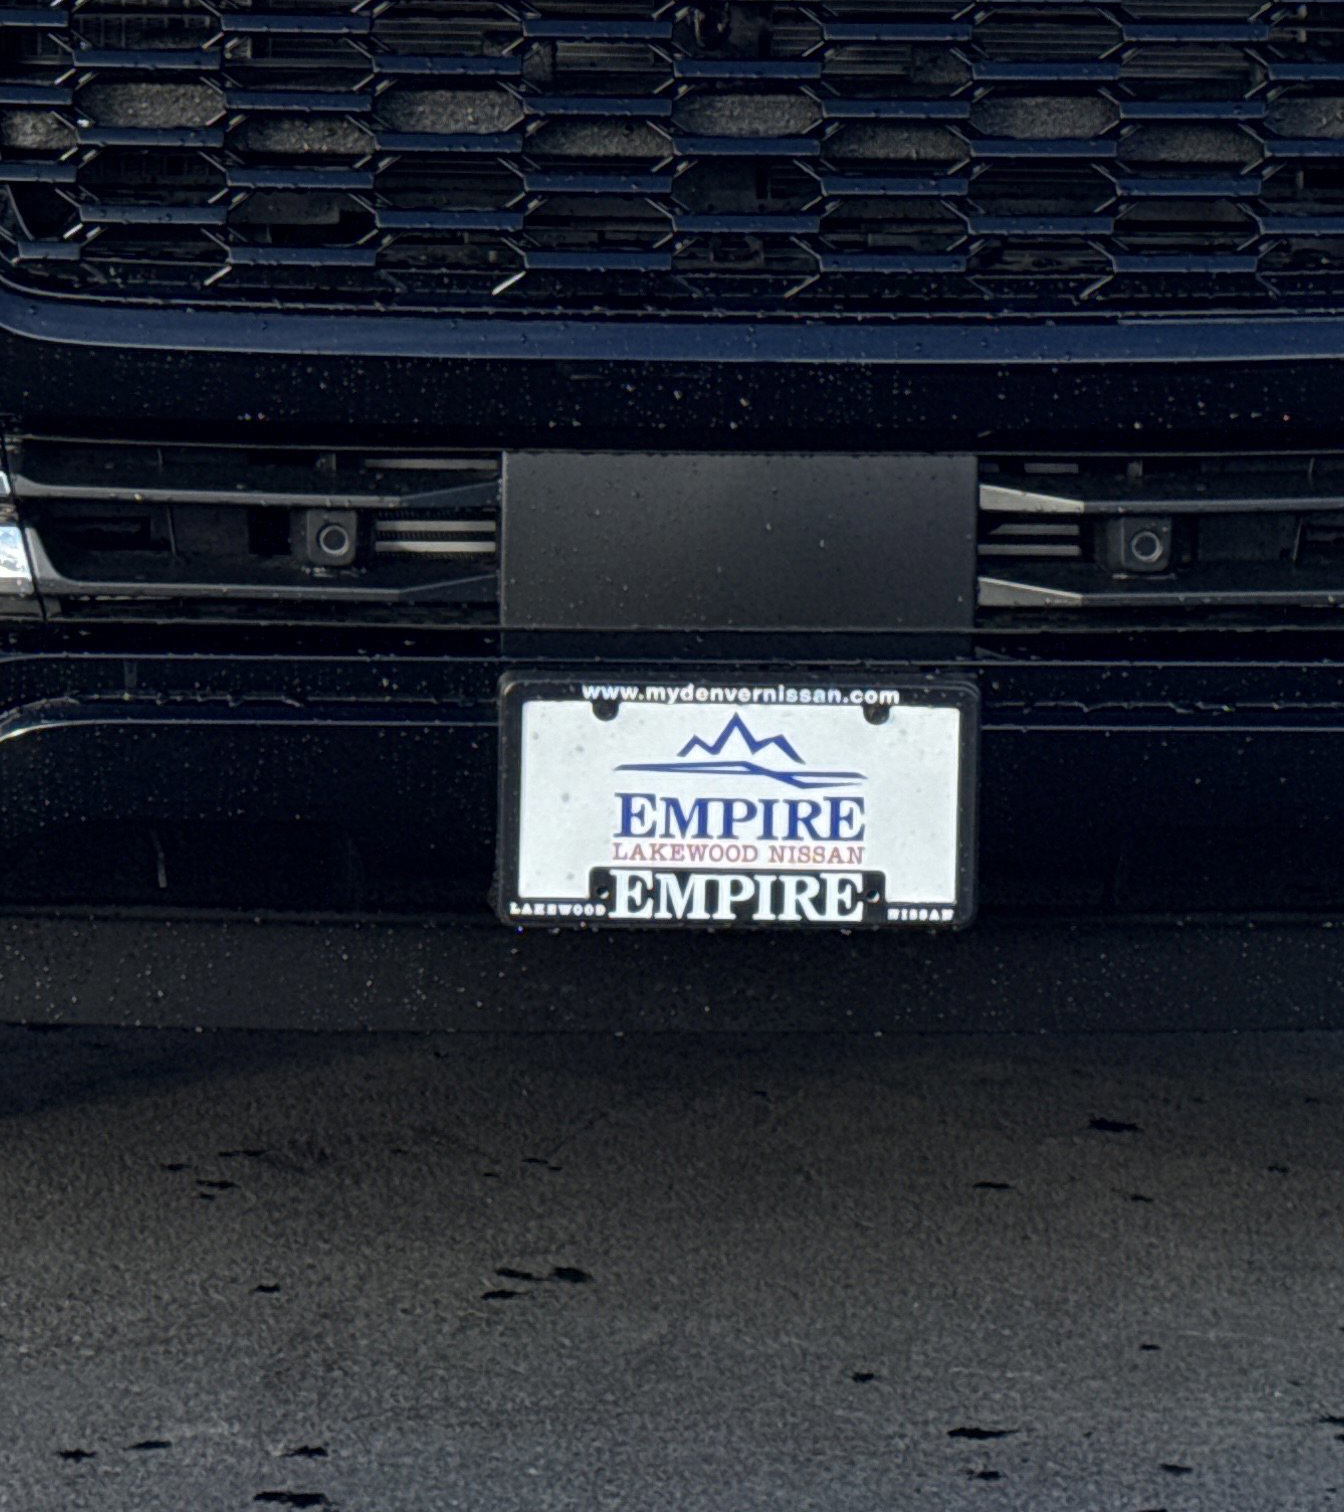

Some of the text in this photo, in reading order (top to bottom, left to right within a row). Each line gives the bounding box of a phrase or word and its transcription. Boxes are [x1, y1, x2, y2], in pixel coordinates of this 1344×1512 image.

[582, 684, 900, 706] www.mydenvernissan.com
[613, 792, 866, 842] EMPIRE
[612, 843, 866, 865] LAKEWOOD NISSAN
[509, 869, 955, 922] LAKEWOOD EMPIRE NISSAN
